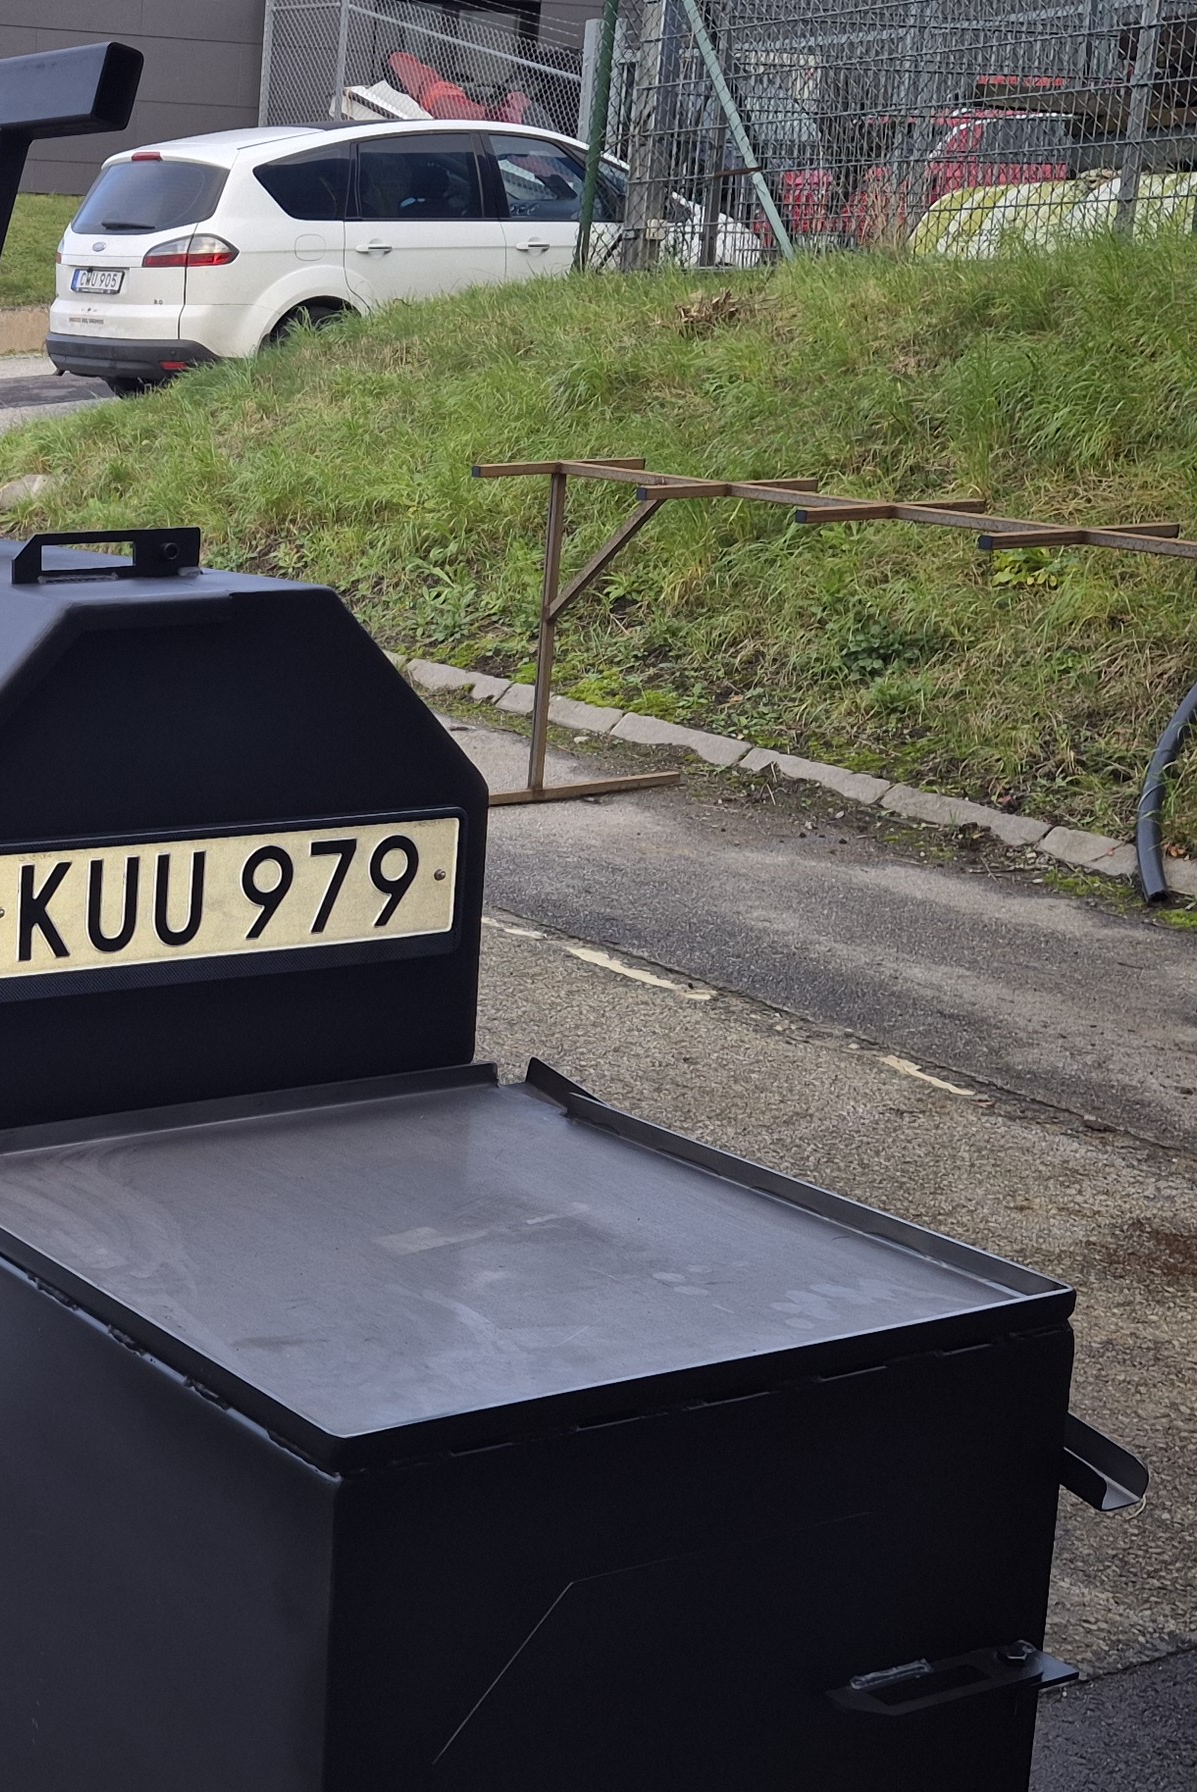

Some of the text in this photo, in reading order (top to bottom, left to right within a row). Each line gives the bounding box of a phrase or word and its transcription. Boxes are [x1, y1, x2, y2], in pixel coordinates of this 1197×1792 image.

[80, 271, 117, 288] CWU 905
[17, 834, 419, 962] KUU 979
